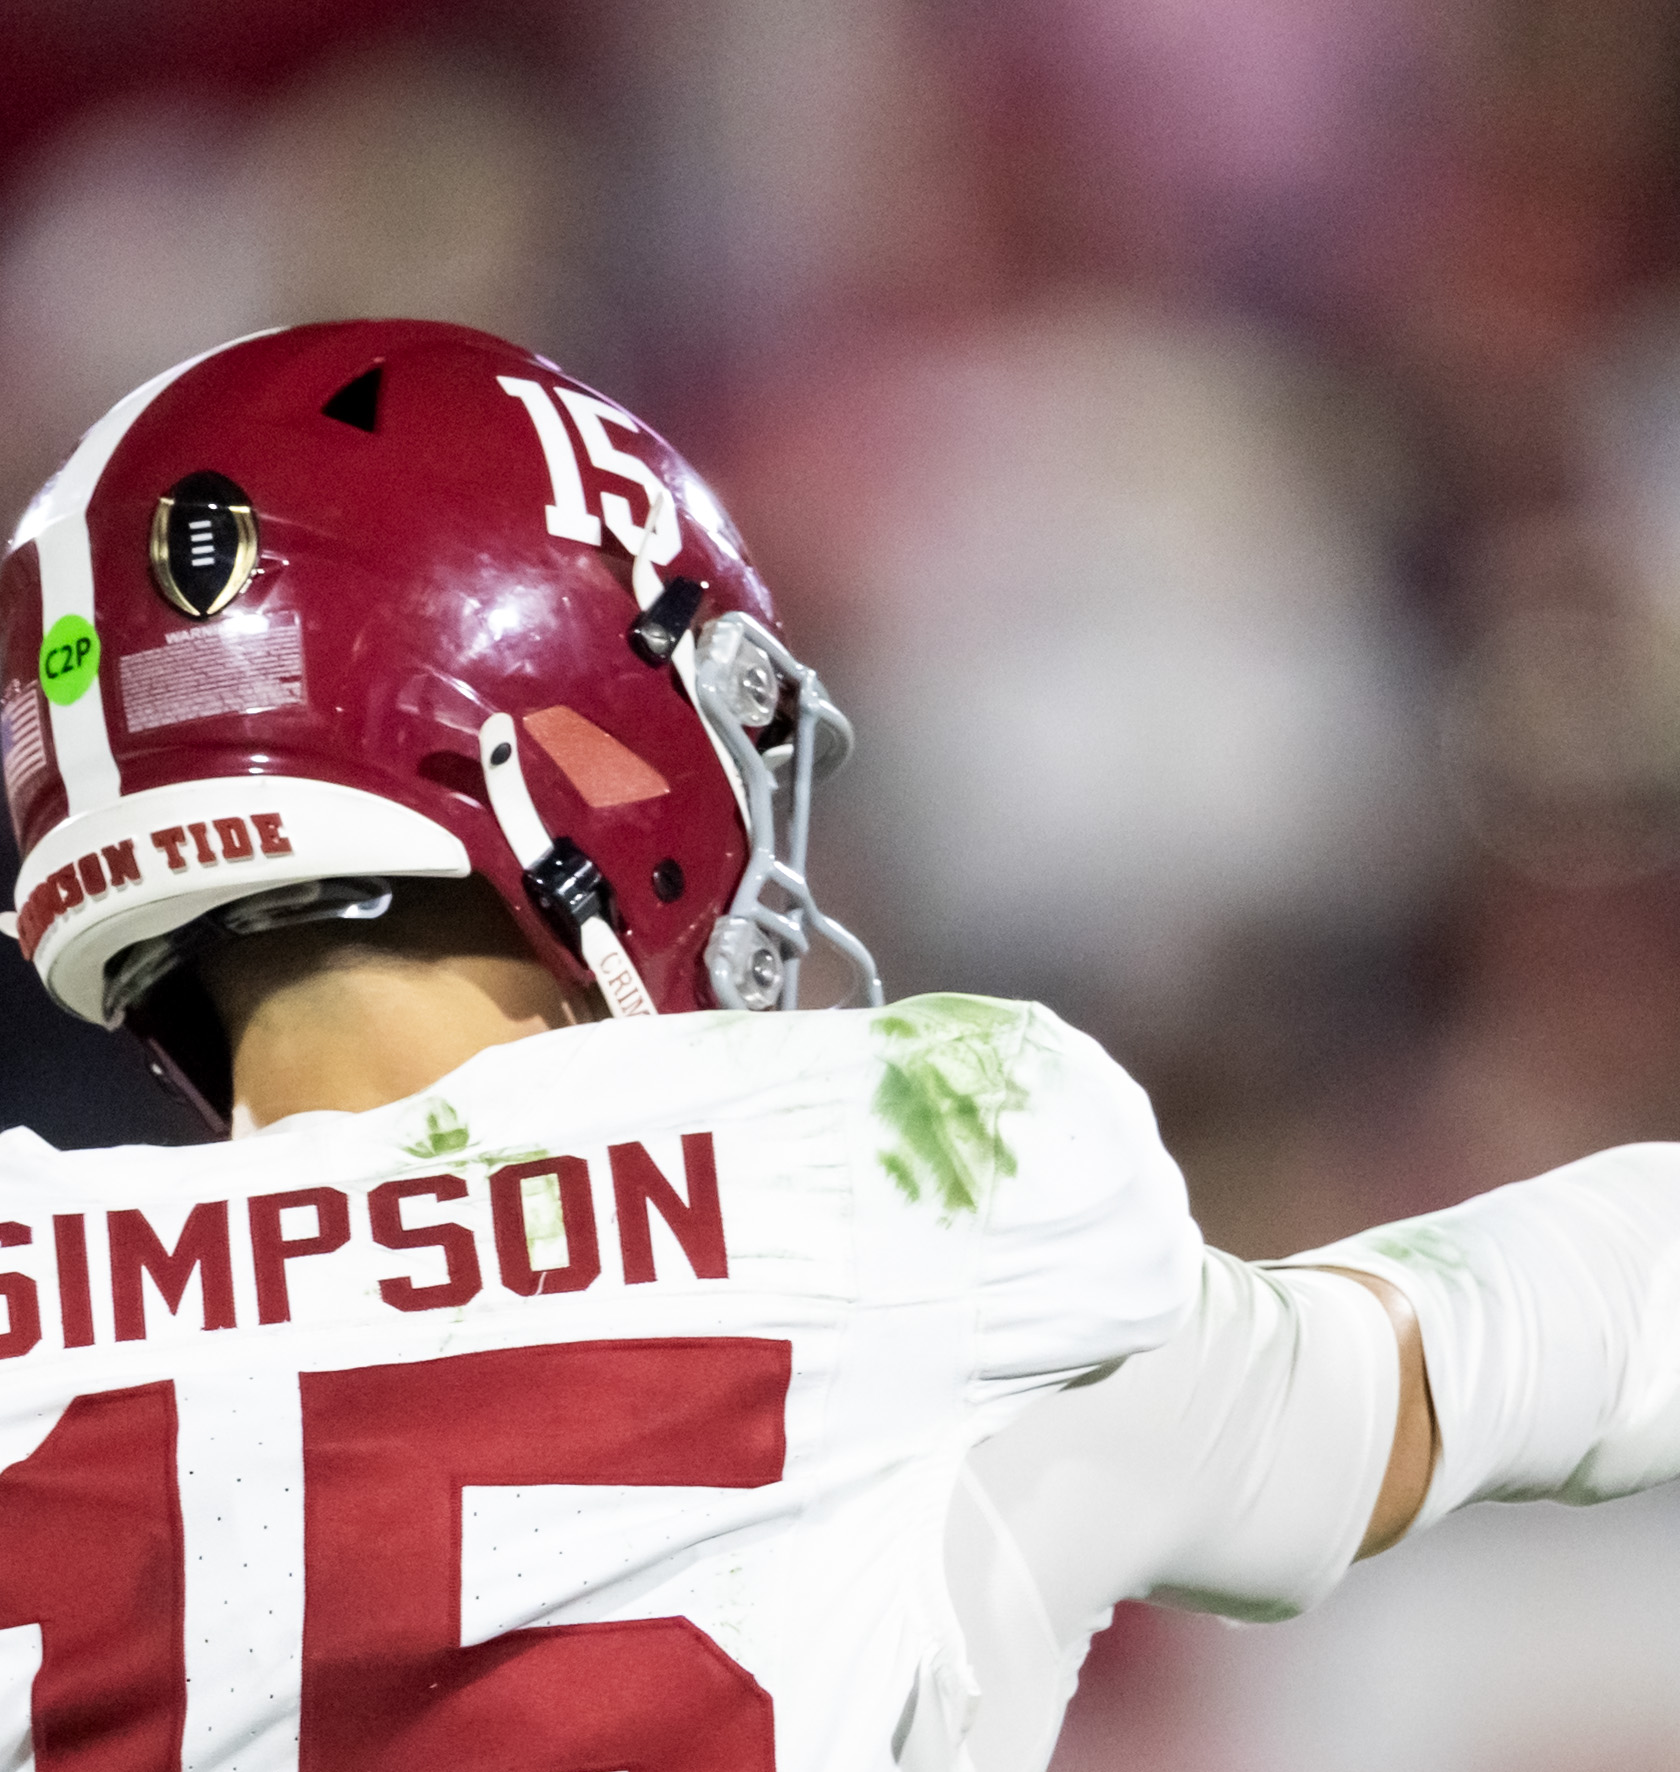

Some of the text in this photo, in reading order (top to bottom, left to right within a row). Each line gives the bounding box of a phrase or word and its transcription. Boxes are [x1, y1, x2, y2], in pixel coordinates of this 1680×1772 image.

[496, 375, 683, 567] 15
[45, 636, 91, 679] C2P
[151, 812, 293, 870] TIDE
